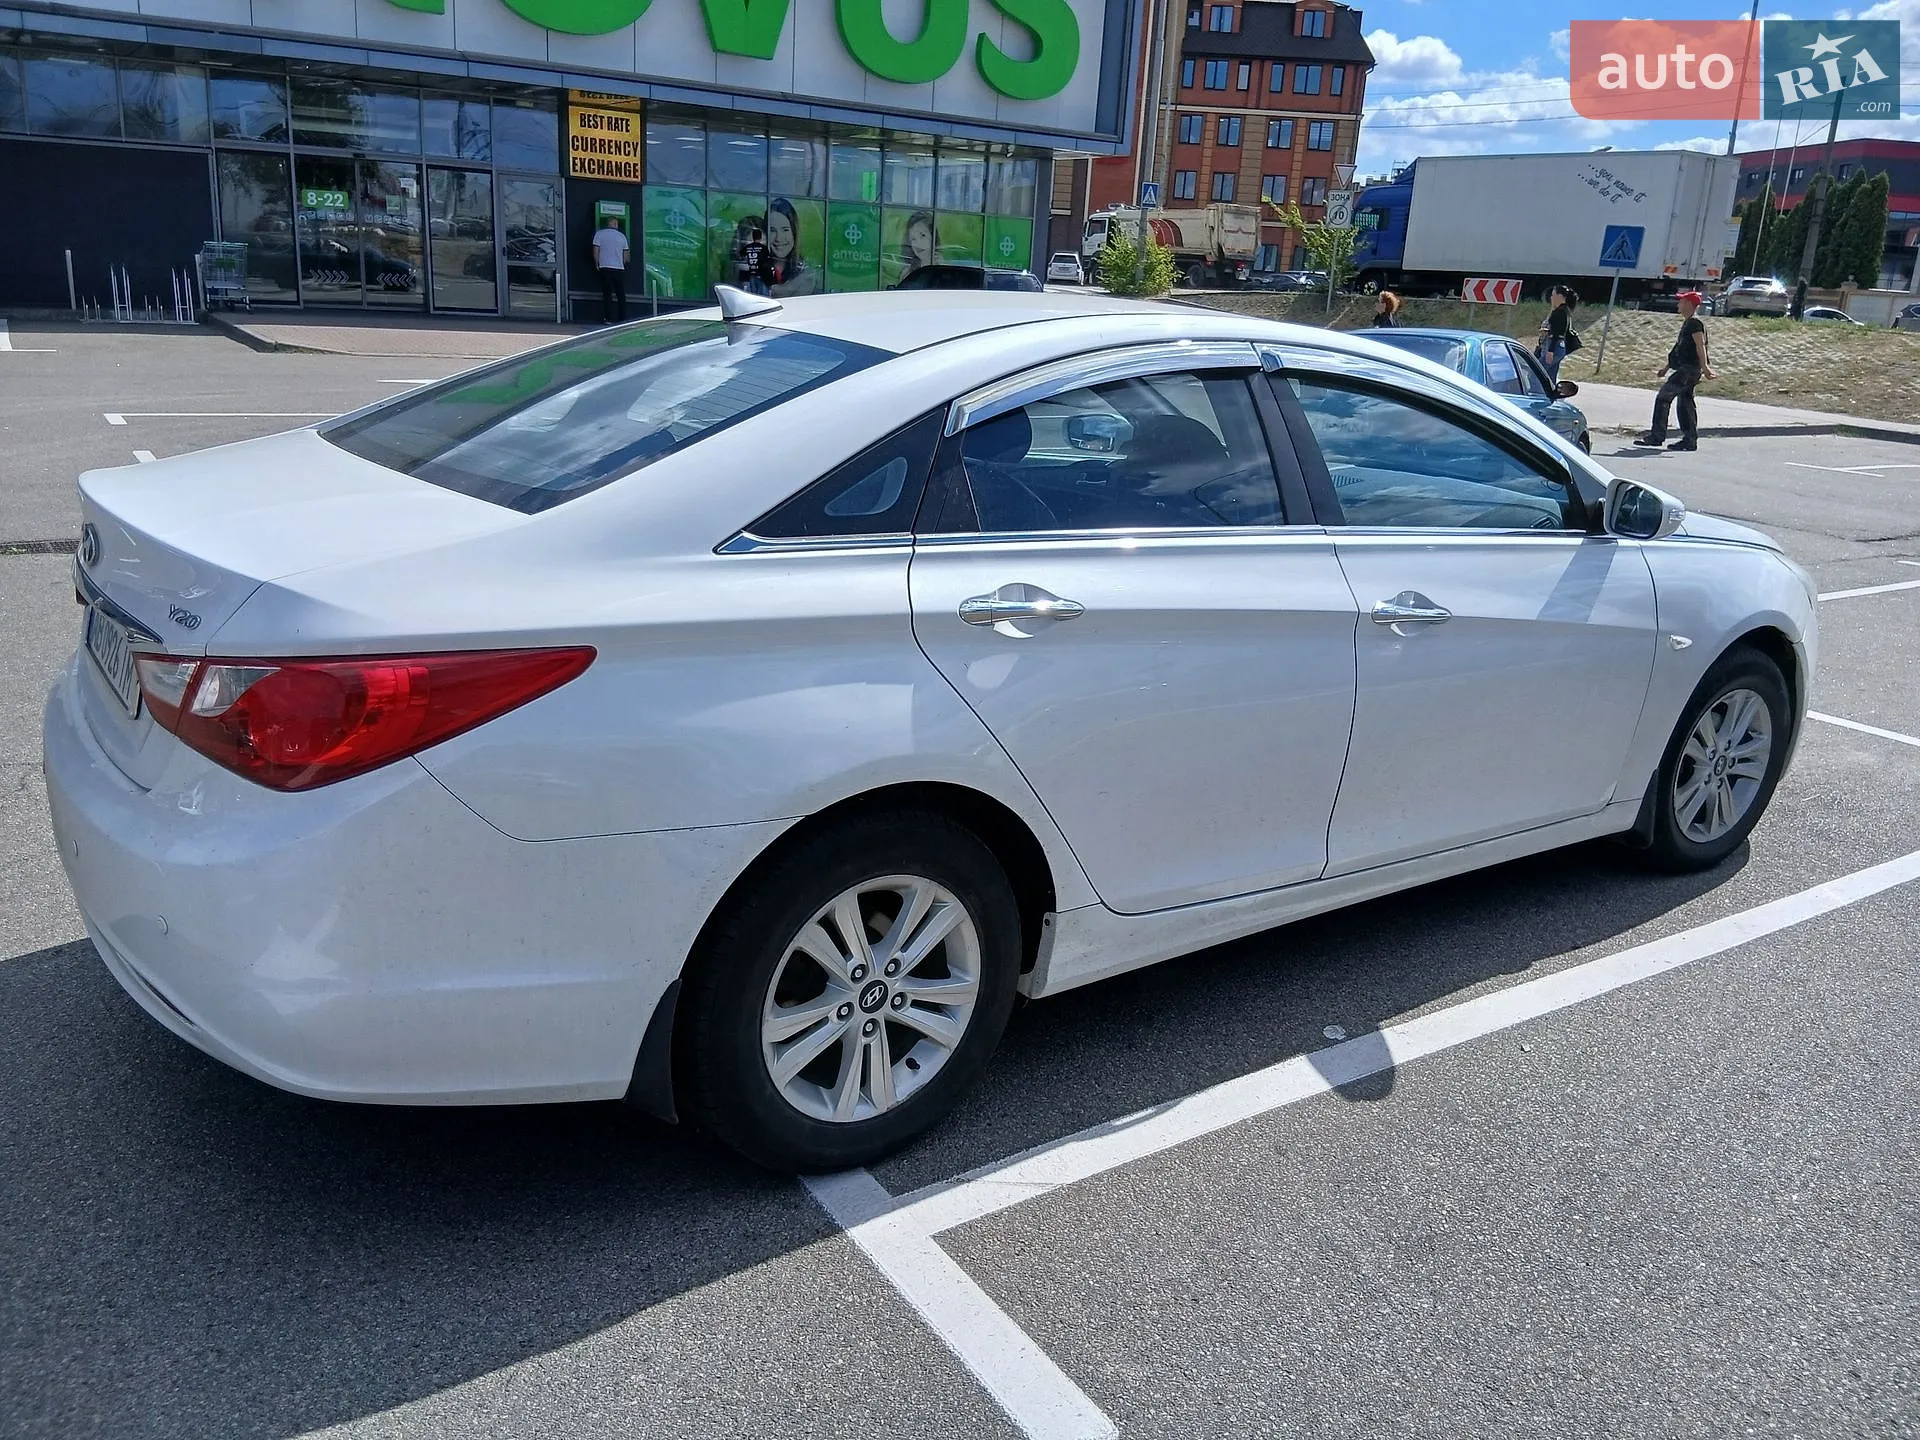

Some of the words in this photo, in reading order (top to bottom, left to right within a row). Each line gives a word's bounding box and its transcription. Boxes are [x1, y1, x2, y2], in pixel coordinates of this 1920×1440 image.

[579, 112, 605, 130] BEST
[606, 115, 630, 133] RATE
[571, 135, 639, 157] CURRENCY
[572, 156, 639, 179] EXCHANGE
[307, 191, 345, 207] 8-22
[1330, 193, 1350, 202] ЗОНА
[832, 249, 873, 262] аптека
[168, 603, 202, 630] Y20
